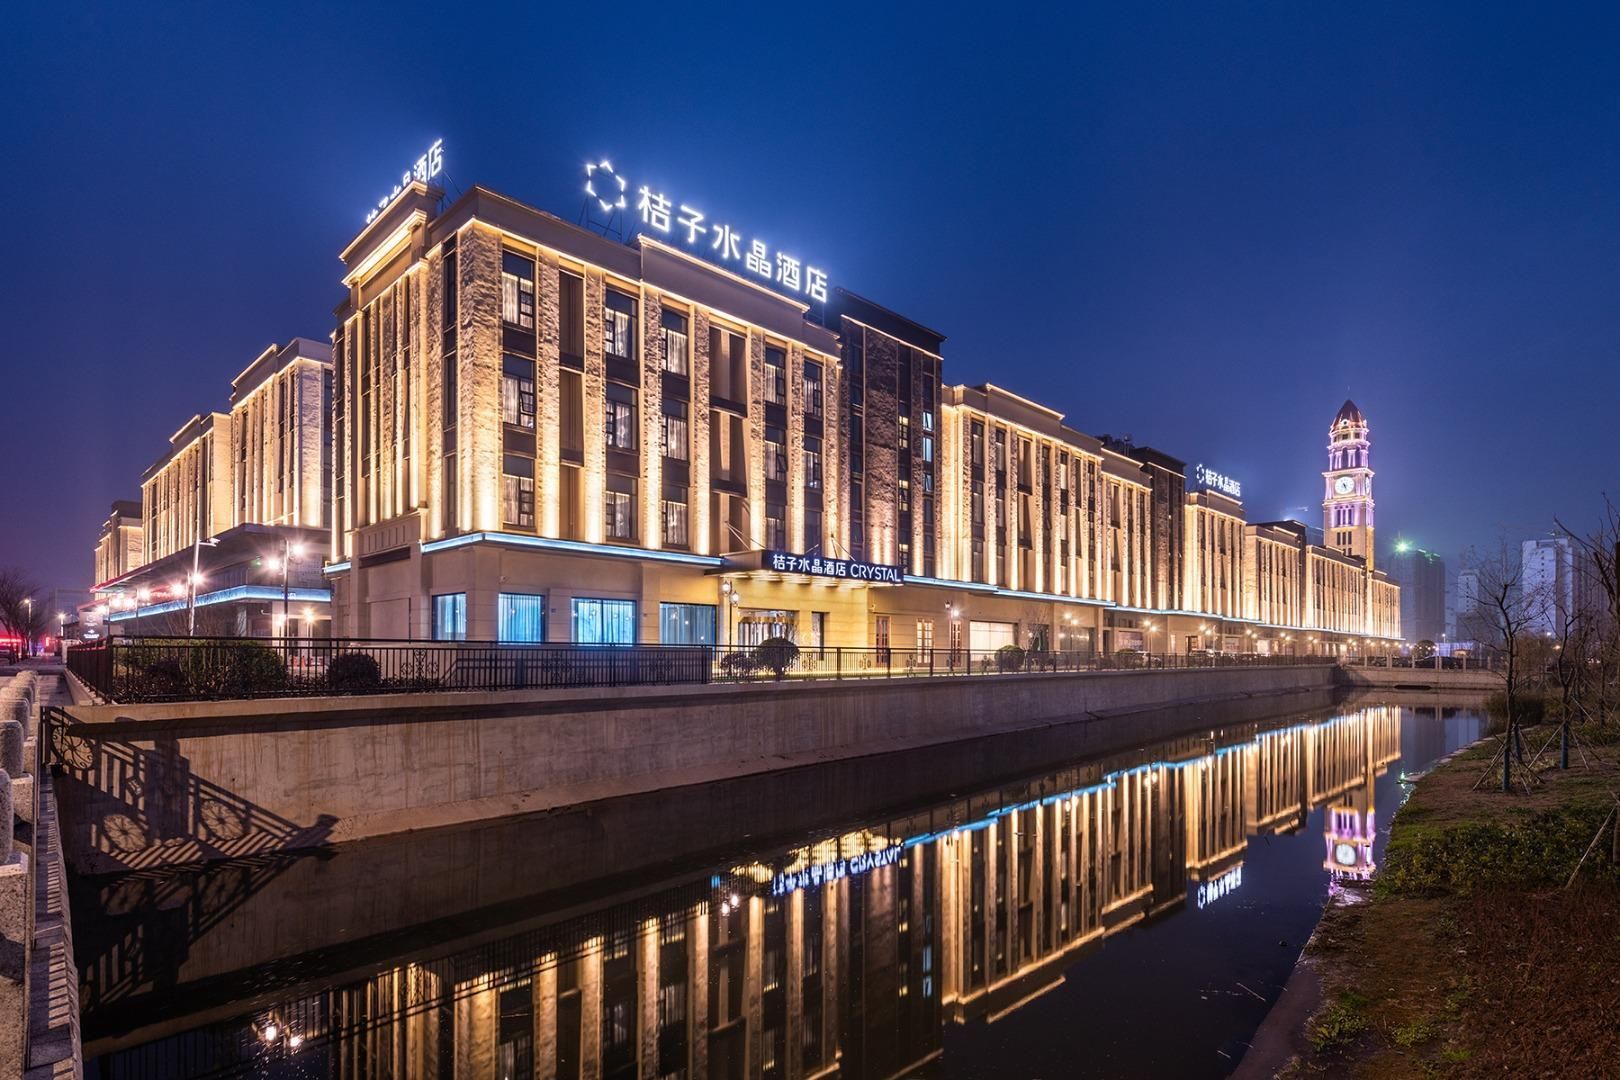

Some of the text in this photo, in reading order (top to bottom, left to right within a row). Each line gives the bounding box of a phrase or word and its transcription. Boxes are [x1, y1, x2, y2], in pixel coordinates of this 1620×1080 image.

[637, 185, 827, 303] 桔子水晶酒店
[773, 553, 900, 582] 桔子水晶酒店 CRYSTAL
